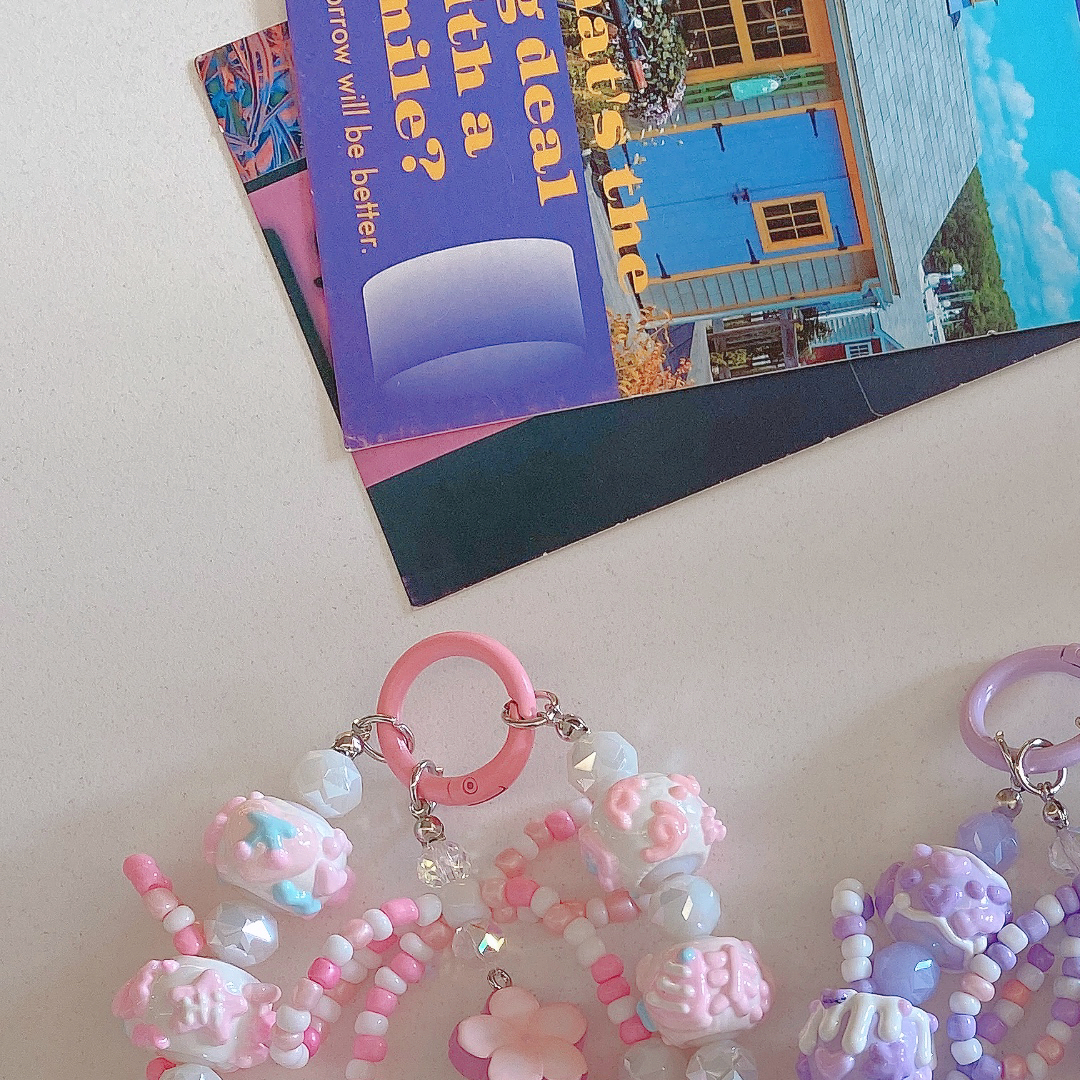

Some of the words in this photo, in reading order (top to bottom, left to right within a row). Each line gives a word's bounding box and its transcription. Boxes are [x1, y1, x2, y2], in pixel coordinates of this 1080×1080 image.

[337, 73, 371, 116] will
[516, 37, 578, 206] deal
[344, 125, 373, 158] be
[461, 112, 493, 158] a
[350, 168, 381, 254] better.
[603, 164, 649, 295] the
